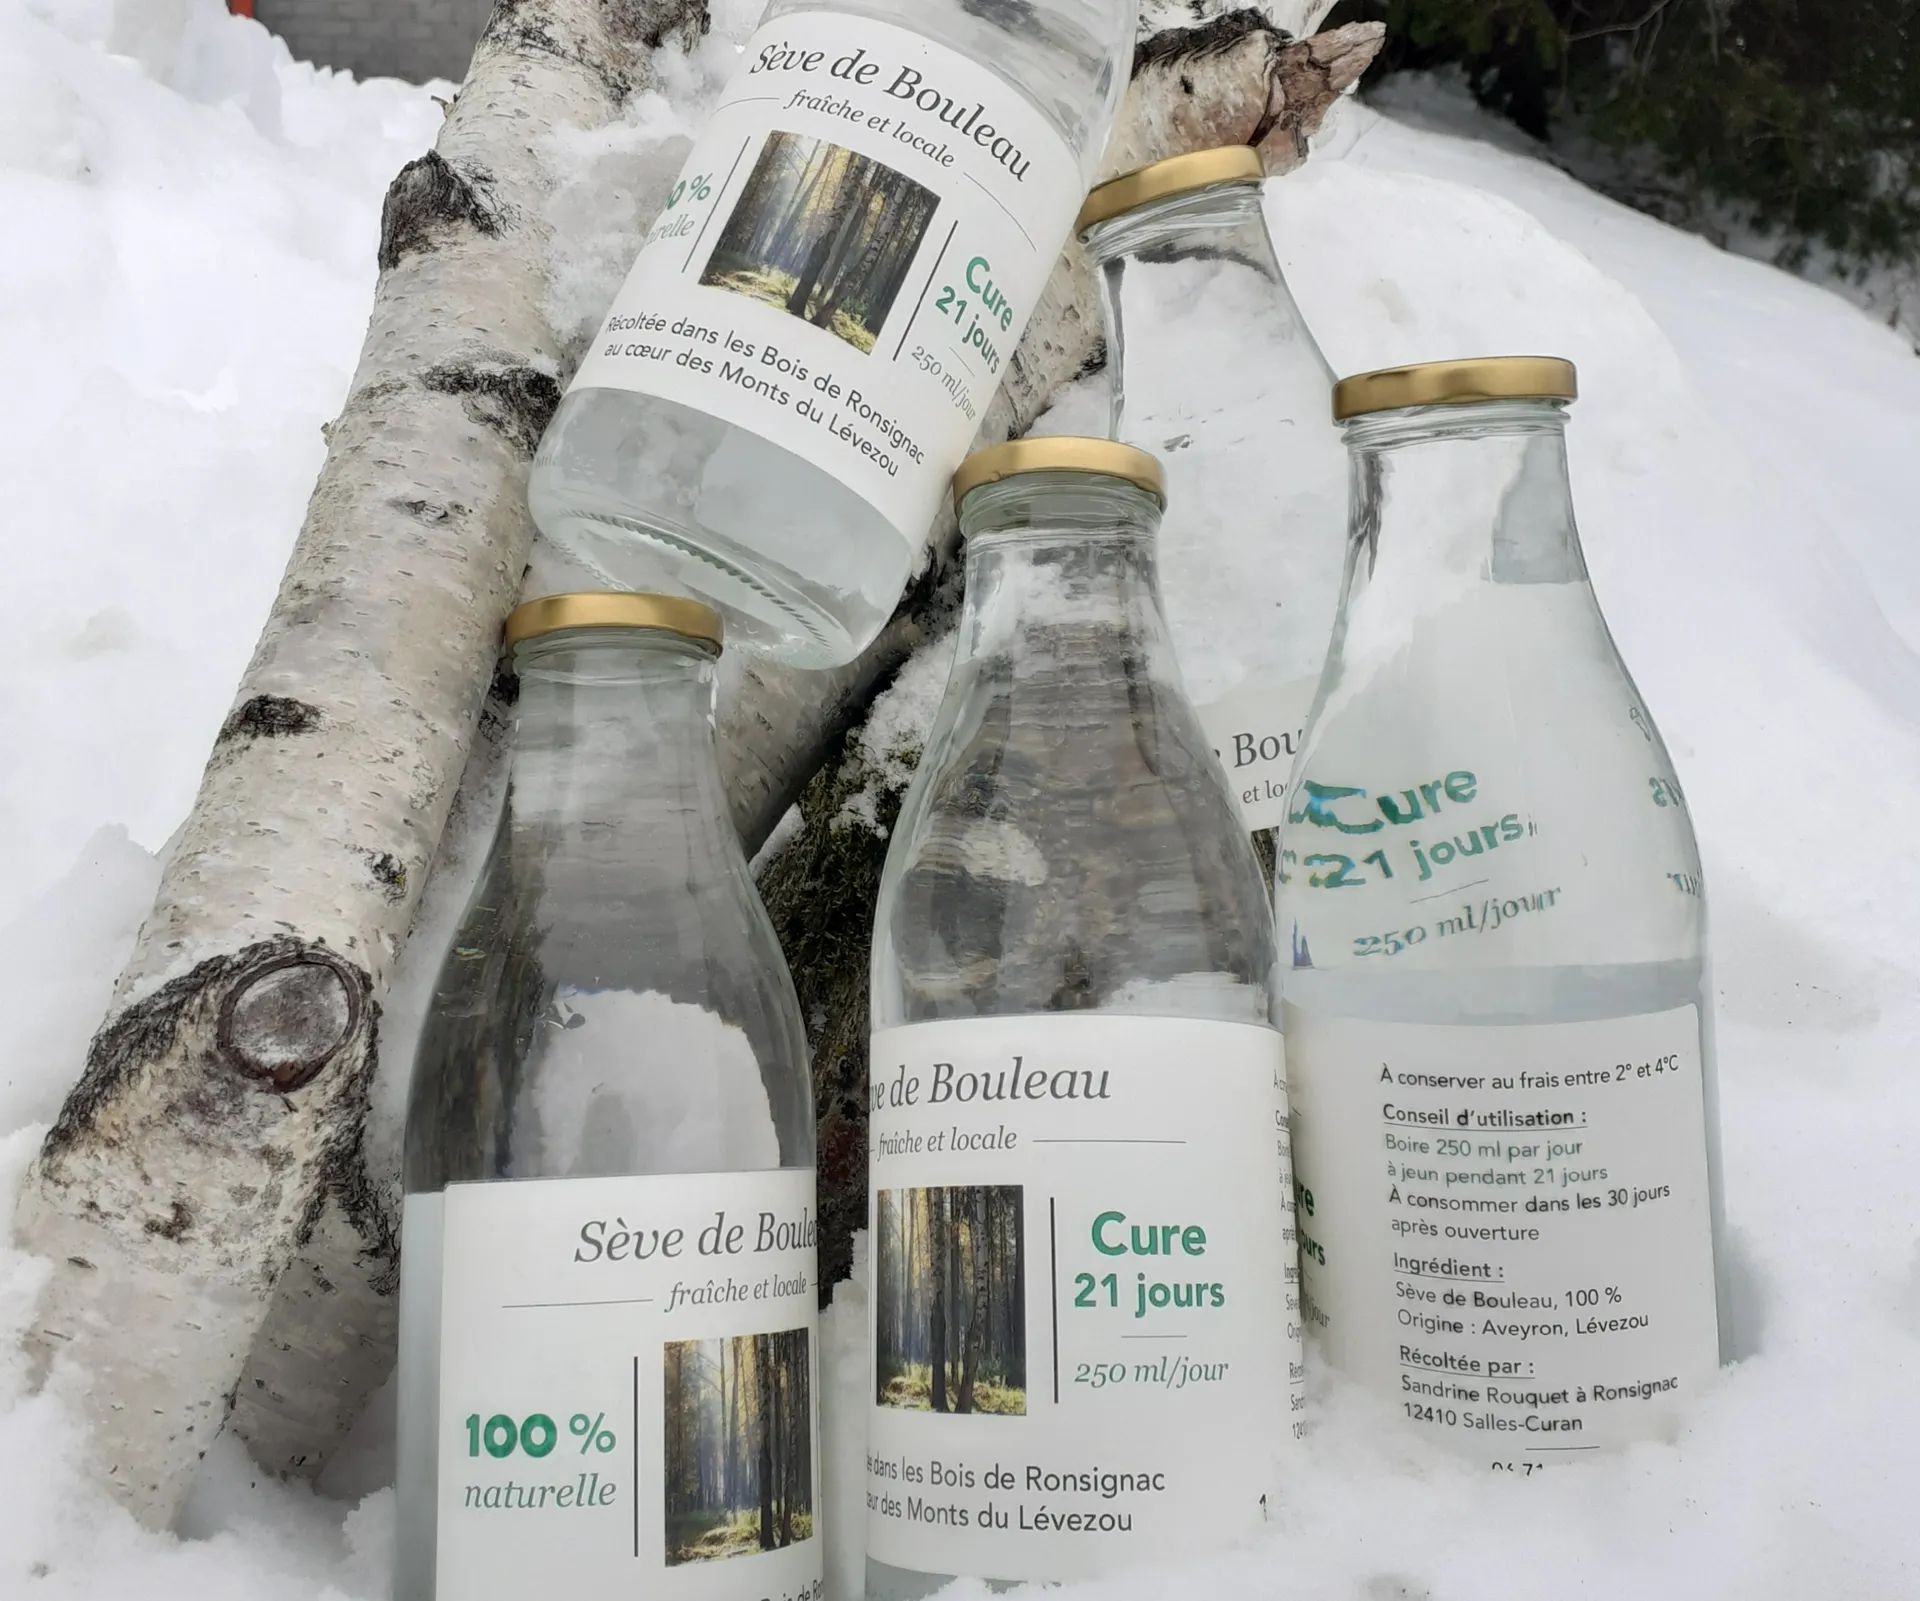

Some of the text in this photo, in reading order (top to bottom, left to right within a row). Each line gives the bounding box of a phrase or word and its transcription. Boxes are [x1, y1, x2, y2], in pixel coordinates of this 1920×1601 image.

[749, 40, 1032, 182] Sève de Bouleau
[784, 89, 955, 169] fraîche et locale
[688, 172, 713, 202] %
[965, 256, 1012, 333] Cure
[936, 286, 1000, 376] 21 jours
[606, 312, 925, 465] Récoltée dans les Bois de Ronsignac
[911, 345, 976, 422] 250 ml/jour
[604, 344, 899, 478] au cœur des Monts du Lévezou
[1243, 780, 1288, 803] et lo
[869, 1056, 1111, 1112] ve de Bouleau
[1380, 1062, 1394, 1083] À
[1398, 1071, 1486, 1090] conserver
[1492, 1074, 1514, 1090] au
[1519, 1071, 1560, 1089] frais
[1564, 1068, 1611, 1087] entre
[1636, 1062, 1652, 1078] et
[1383, 1104, 1449, 1125] Conseil
[1580, 1112, 1587, 1124] :
[877, 1125, 1017, 1162] fraîche et locale
[1385, 1134, 1583, 1164] Boire 250 ml par jour
[1388, 1161, 1609, 1189] à jeun pendant 21 jours
[1389, 1183, 1671, 1213] À consommer dans les 30 jours
[574, 1217, 684, 1264] Sève
[698, 1212, 744, 1256] de
[1091, 1211, 1206, 1256] Cure
[1391, 1217, 1540, 1242] après ouverture
[1394, 1252, 1504, 1278] Ingrédient :
[664, 1271, 807, 1313] fraîche et locale
[1073, 1274, 1226, 1318] 21 jours
[1395, 1282, 1623, 1309] Sève de Bouleau, 100 %
[1397, 1309, 1650, 1339] Origine : Aveyron, Lévezou
[1074, 1354, 1229, 1388] 250 ml/jour
[1400, 1345, 1535, 1378] Récoltée par :
[1401, 1374, 1679, 1409] Sandrine Rouquet à Ronsignac
[465, 1411, 616, 1459] 100 %
[1404, 1402, 1583, 1432] 12410 Salles-Curan
[463, 1472, 616, 1510] naturelle
[874, 1450, 897, 1480] dans
[901, 1455, 924, 1483] les
[930, 1461, 975, 1487] Bois
[984, 1463, 1015, 1490] de
[1026, 1466, 1165, 1499] Ronsignac
[880, 1490, 902, 1518] des
[907, 1495, 969, 1527] Monts
[977, 1500, 1009, 1529] du
[1020, 1505, 1133, 1533] Lévezou
